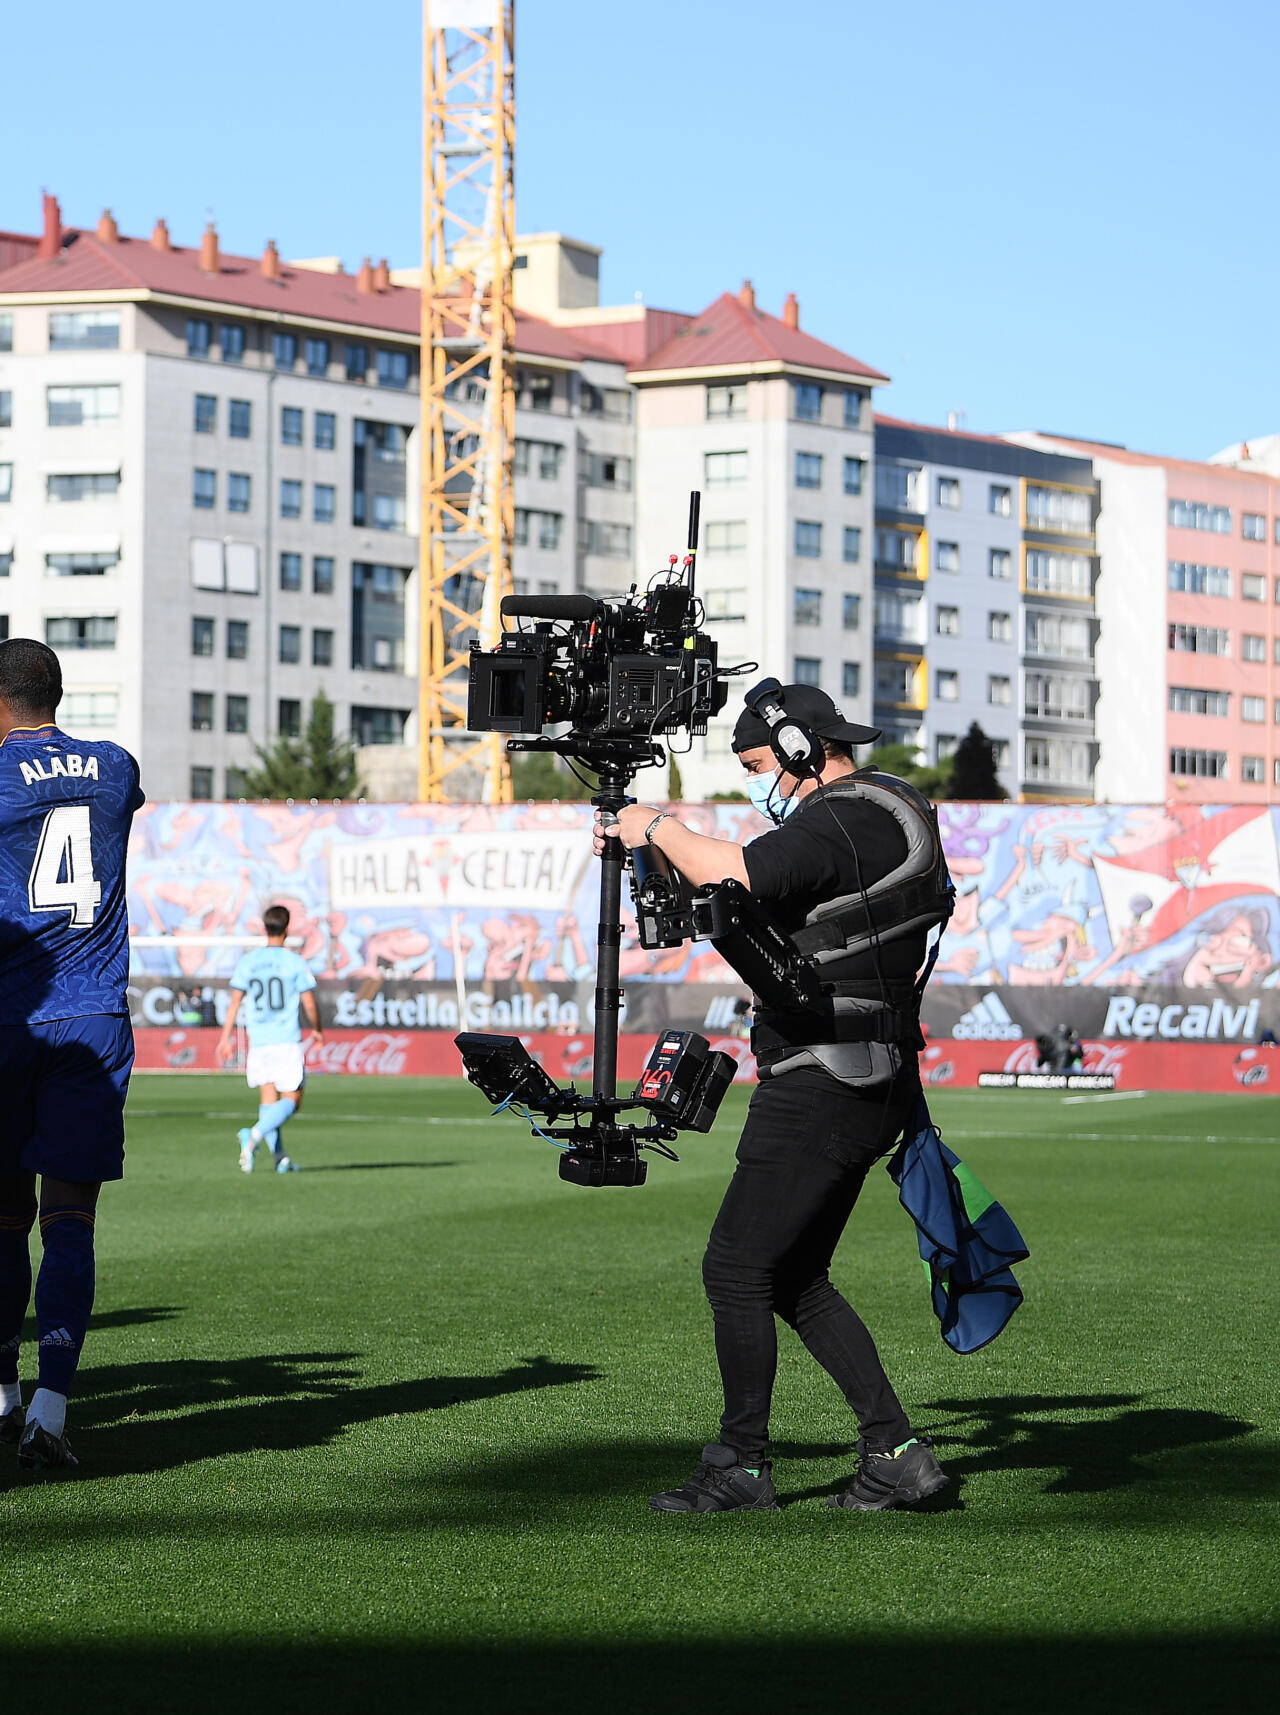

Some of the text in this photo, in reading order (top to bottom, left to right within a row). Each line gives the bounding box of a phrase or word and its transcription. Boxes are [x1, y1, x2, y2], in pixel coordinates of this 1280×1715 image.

[19, 754, 99, 786] ALABA
[27, 805, 102, 929] 4
[340, 847, 572, 895] HALA CELTA!
[248, 976, 285, 1011] 20
[333, 990, 461, 1027] Estrella
[465, 991, 580, 1028] Galicia
[952, 1023, 1023, 1040] adidas
[1103, 996, 1260, 1039] Recalvi
